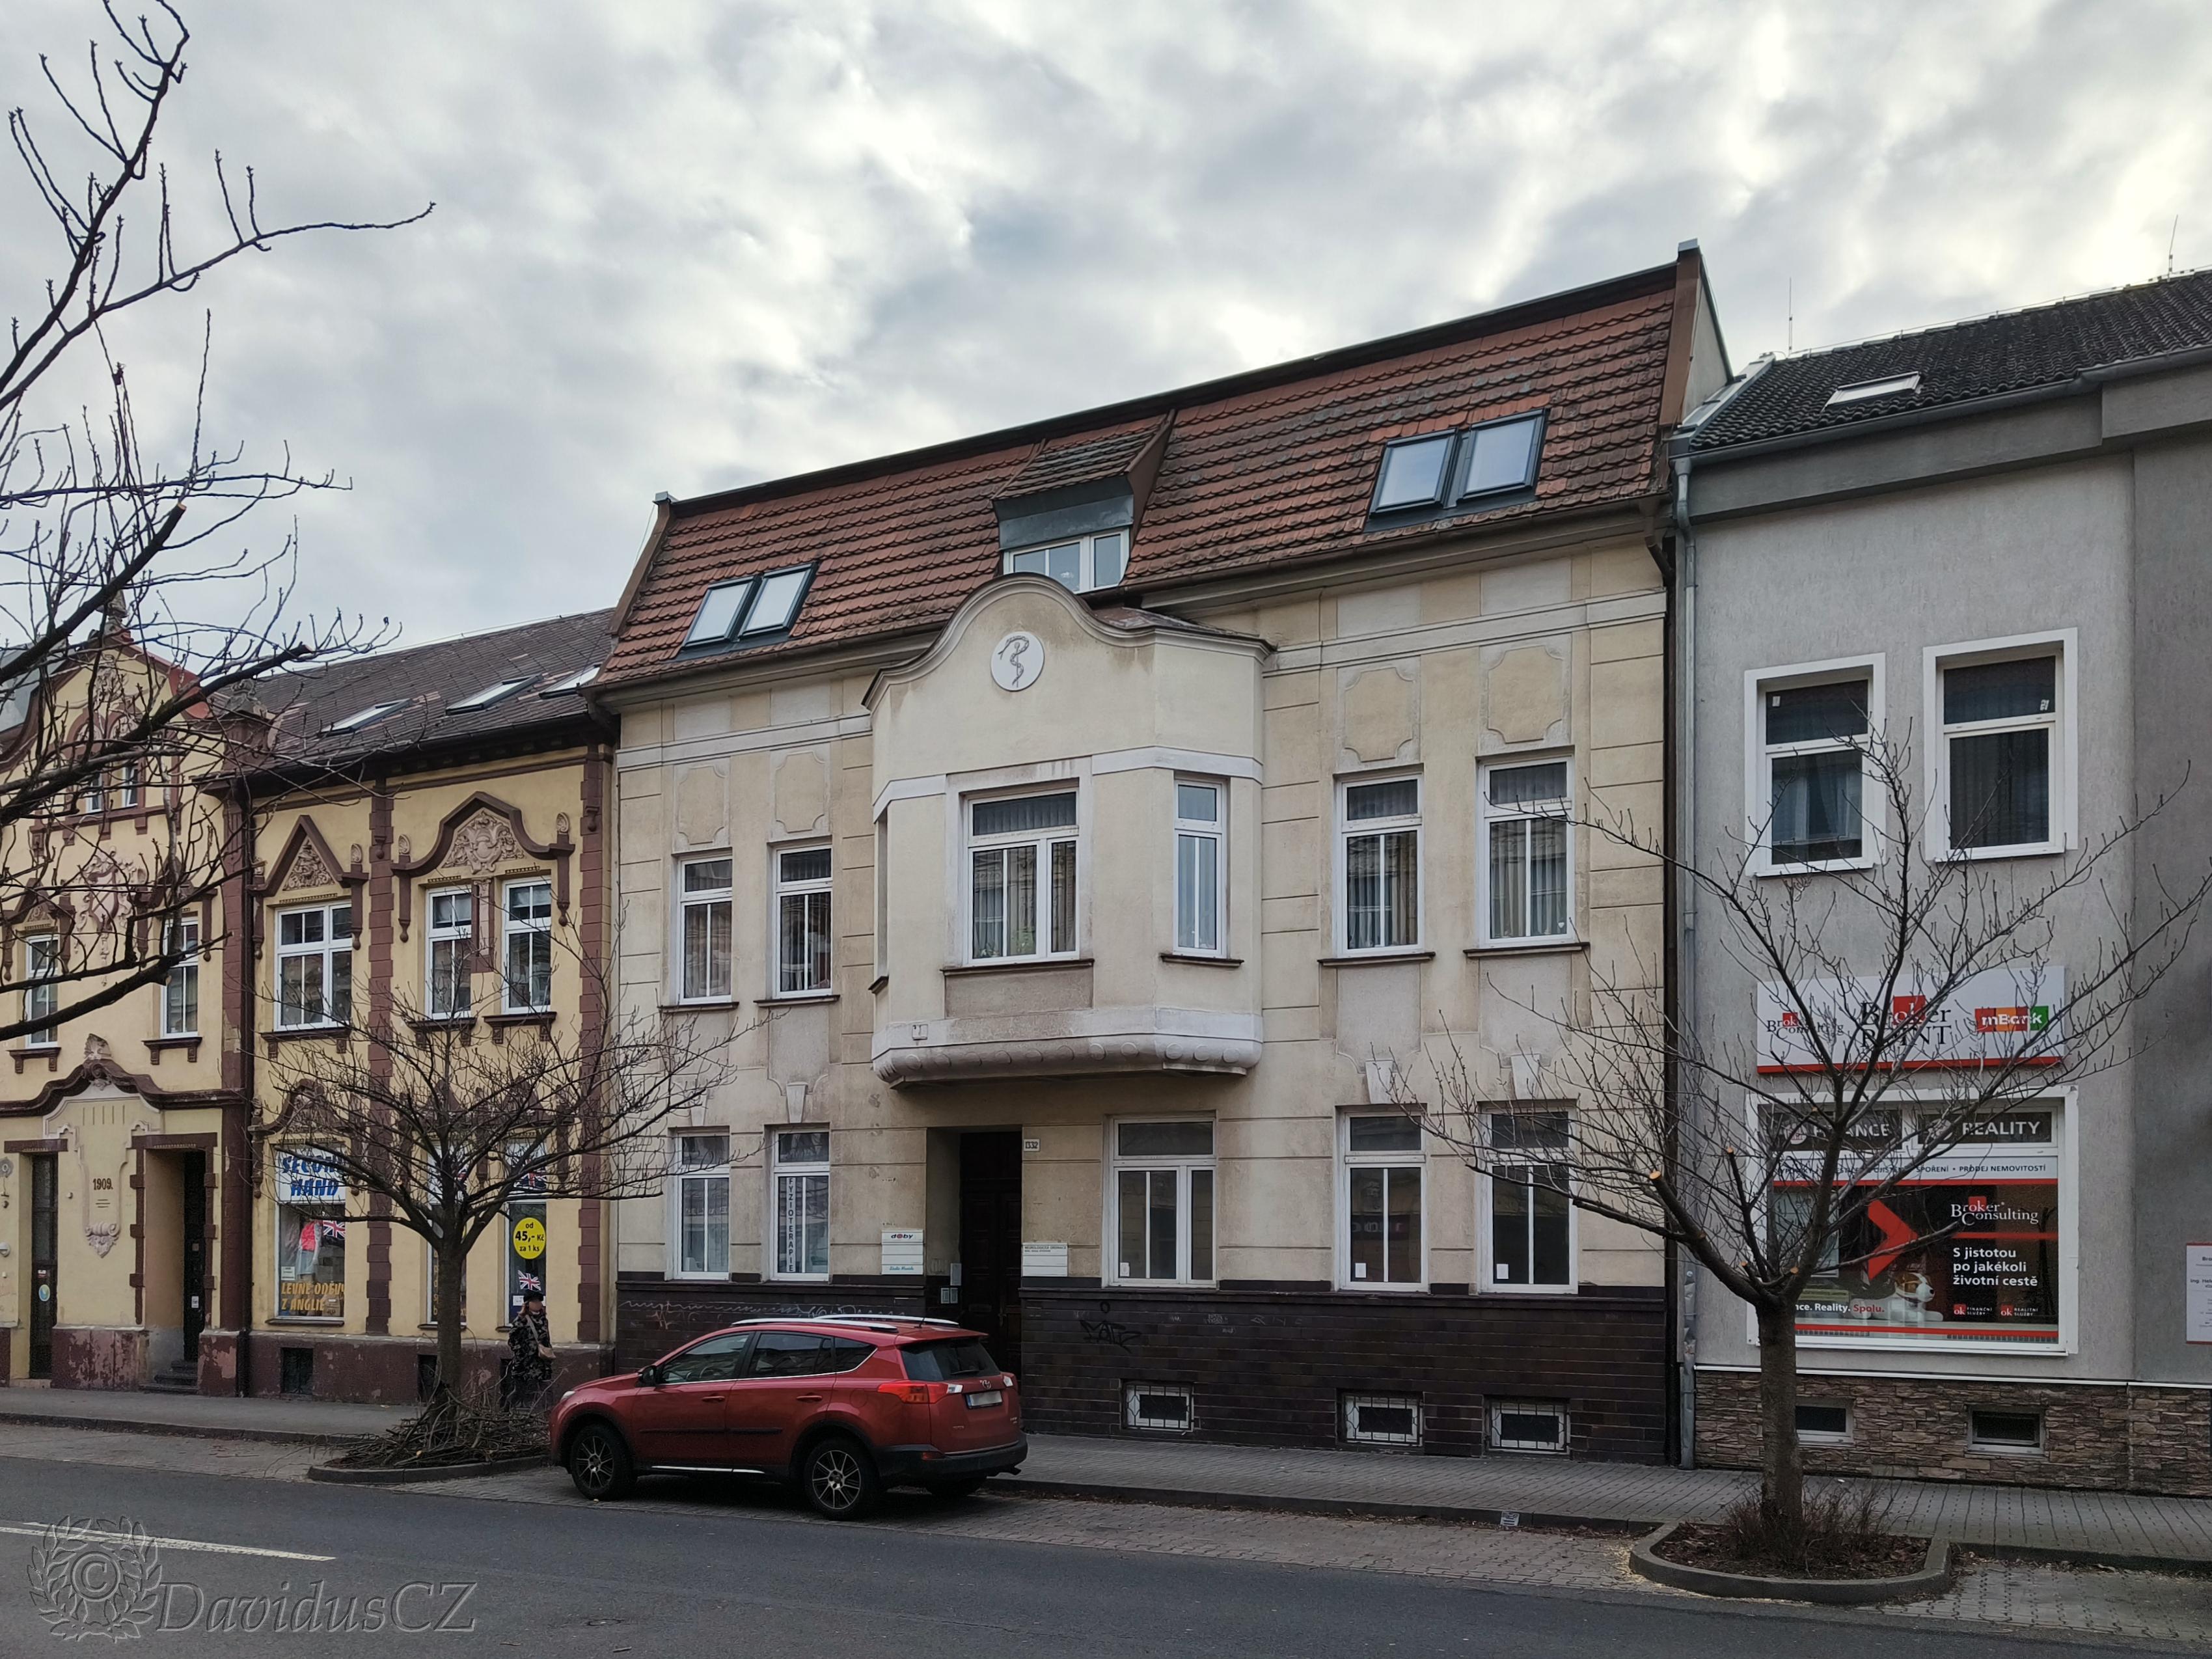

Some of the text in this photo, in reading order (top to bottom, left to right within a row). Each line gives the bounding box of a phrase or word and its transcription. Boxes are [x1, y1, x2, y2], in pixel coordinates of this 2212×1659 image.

[1962, 1121, 2041, 1136] REALITY
[1916, 1164, 1949, 1173] SPOŘENÍ
[1991, 1164, 2046, 1172] NEMOVITOSTÍ
[92, 1177, 114, 1190] 1909.
[291, 1177, 338, 1196] HAND
[1950, 1200, 2000, 1217] Broker
[1961, 1208, 2039, 1226] Consulting
[1953, 1247, 2017, 1259] S jistotou
[1953, 1261, 2027, 1274] po jakékoli
[1952, 1274, 2038, 1287] životní cestě
[281, 1298, 325, 1311] Z ANGLIE
[1814, 1303, 1851, 1313] Reality.
[1853, 1304, 1885, 1313] Spolu.
[1954, 1306, 1965, 1315] ok
[2000, 1308, 2013, 1316] ok
